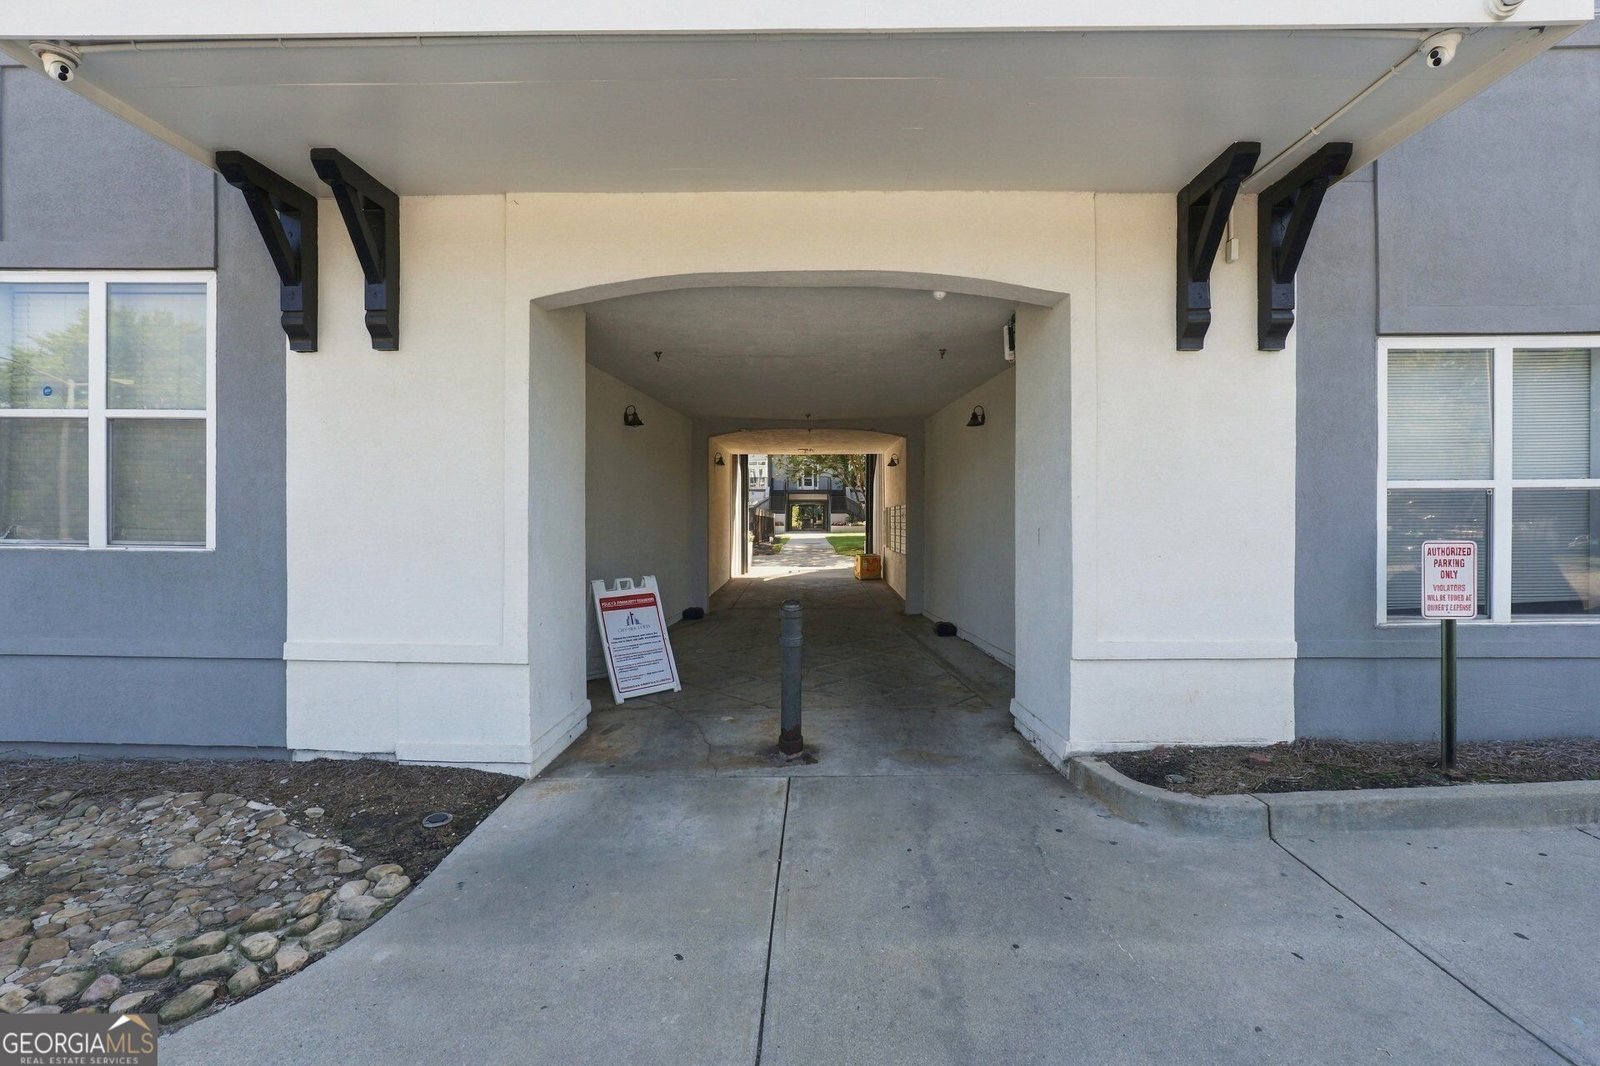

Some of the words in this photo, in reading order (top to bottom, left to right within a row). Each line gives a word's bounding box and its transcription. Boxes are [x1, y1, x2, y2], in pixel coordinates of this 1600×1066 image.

[1427, 547, 1472, 556] AUTHORIZED
[1434, 559, 1465, 567] PARKING
[1440, 570, 1458, 579] ONLY
